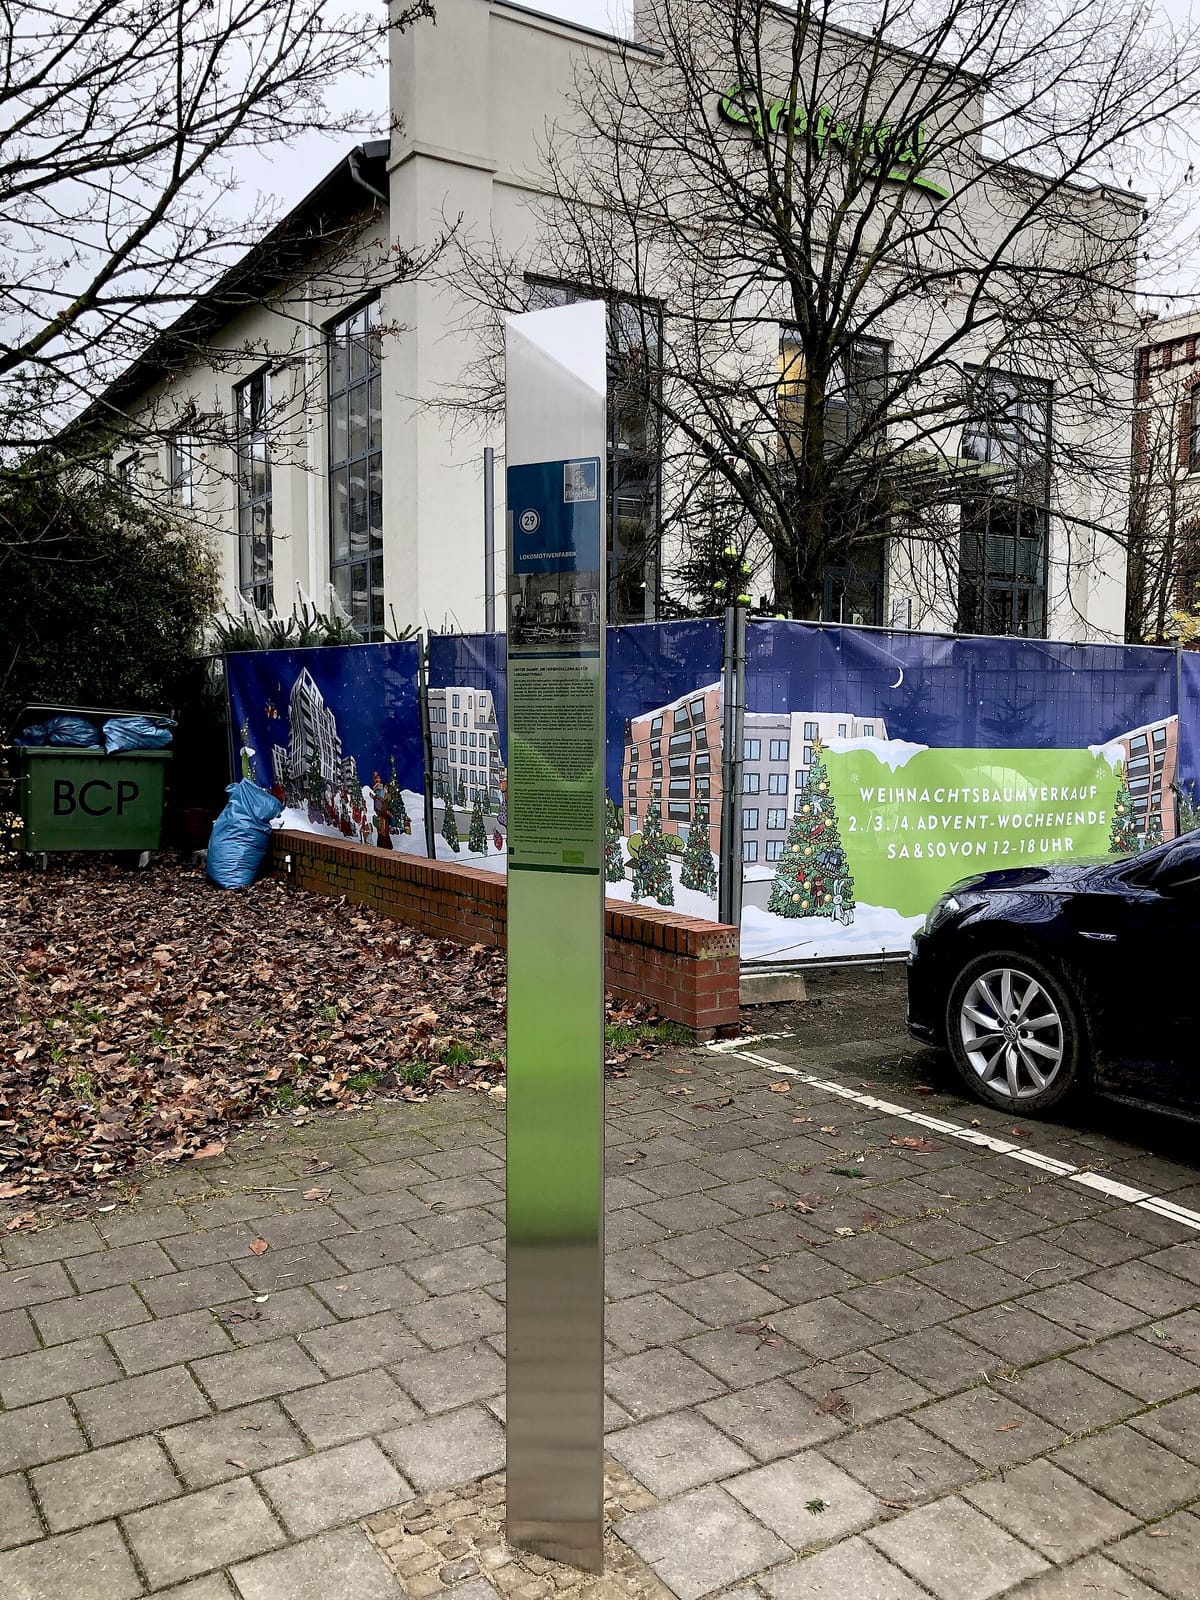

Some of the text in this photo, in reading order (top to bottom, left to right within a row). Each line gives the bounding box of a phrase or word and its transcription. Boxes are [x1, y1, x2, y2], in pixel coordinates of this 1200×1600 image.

[524, 515, 535, 526] 29
[519, 551, 577, 560] LOKOMOTIVENFABRIK
[53, 779, 140, 817] BCP
[859, 786, 1098, 803] WEIHNACHTSBAUMVERKAUF
[992, 838, 1036, 856] 12-18
[1038, 837, 1074, 853] UHR
